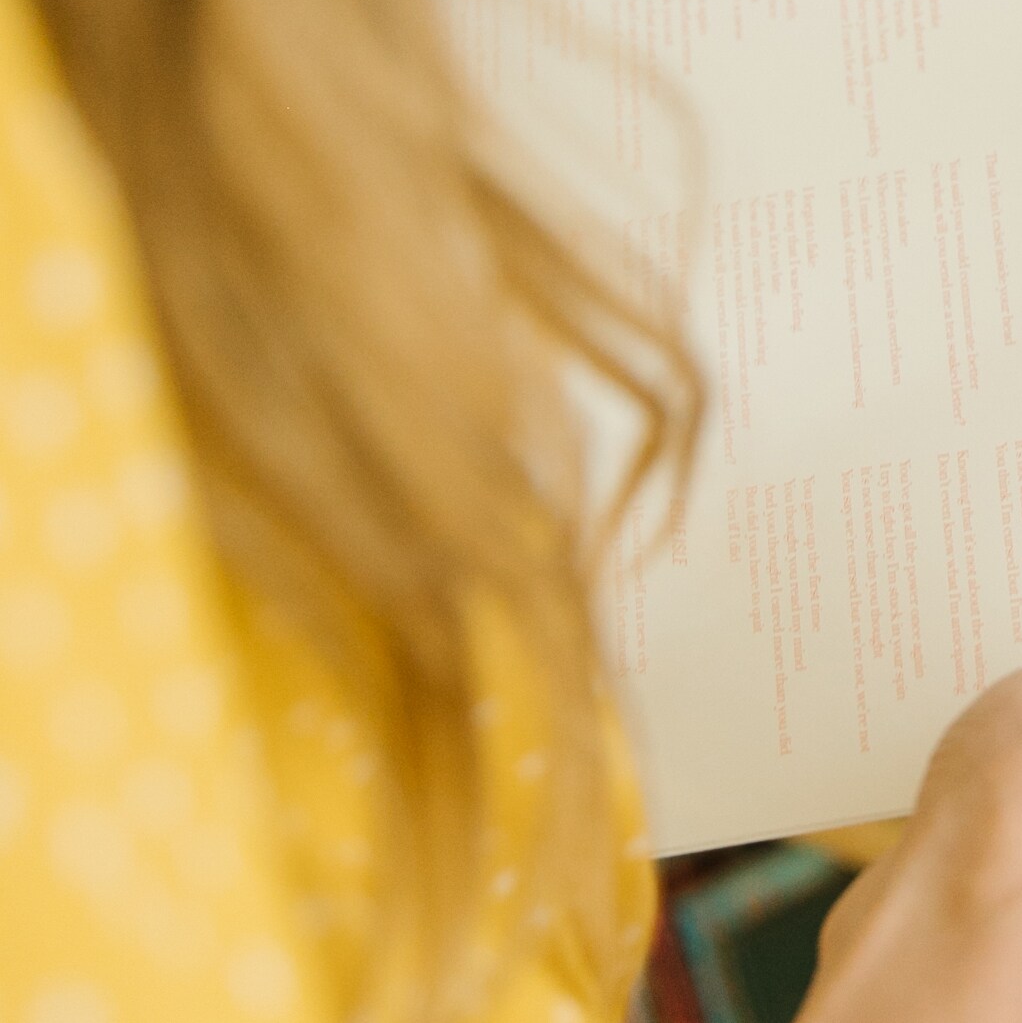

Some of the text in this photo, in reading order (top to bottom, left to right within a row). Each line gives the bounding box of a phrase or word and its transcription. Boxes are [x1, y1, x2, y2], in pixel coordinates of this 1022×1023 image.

[840, 468, 853, 494] You
[877, 469, 889, 487] try
[956, 449, 971, 505] Knowing
[726, 487, 739, 521] Even
[764, 484, 777, 508] And
[839, 495, 852, 515] say
[881, 490, 890, 503] to
[940, 489, 951, 521] even
[727, 522, 740, 532] if
[762, 510, 774, 534] you
[879, 505, 895, 534] fight
[961, 505, 974, 532] that
[844, 517, 856, 552] we're
[942, 521, 955, 556] know
[963, 533, 976, 552] it's
[994, 441, 1022, 643] You think I'm cursed but I'm not
[728, 541, 741, 563] did
[744, 484, 764, 634] But did you have to quit
[765, 536, 781, 585] thought
[800, 474, 822, 632] You gave up the first time
[860, 465, 885, 658] It's not worse than you thought
[965, 554, 976, 576] not
[783, 477, 807, 672] You thought you read my mind
[847, 554, 861, 599] cursed
[887, 562, 899, 584] I'm
[898, 458, 926, 679] You've got all the power once again
[946, 558, 958, 591] what
[850, 600, 862, 623] but
[888, 586, 902, 622] stuck
[948, 593, 961, 615] I'm
[967, 578, 980, 616] about
[771, 595, 784, 633] cared
[891, 623, 902, 636] in
[971, 617, 984, 640] the
[772, 635, 783, 670] more
[852, 625, 865, 660] we're
[888, 638, 903, 669] your
[949, 616, 965, 695] anticipating
[774, 671, 788, 703] than
[891, 670, 907, 701] spin
[773, 704, 787, 731] you
[856, 690, 870, 728] we're
[778, 732, 792, 756] did
[858, 729, 870, 753] not
